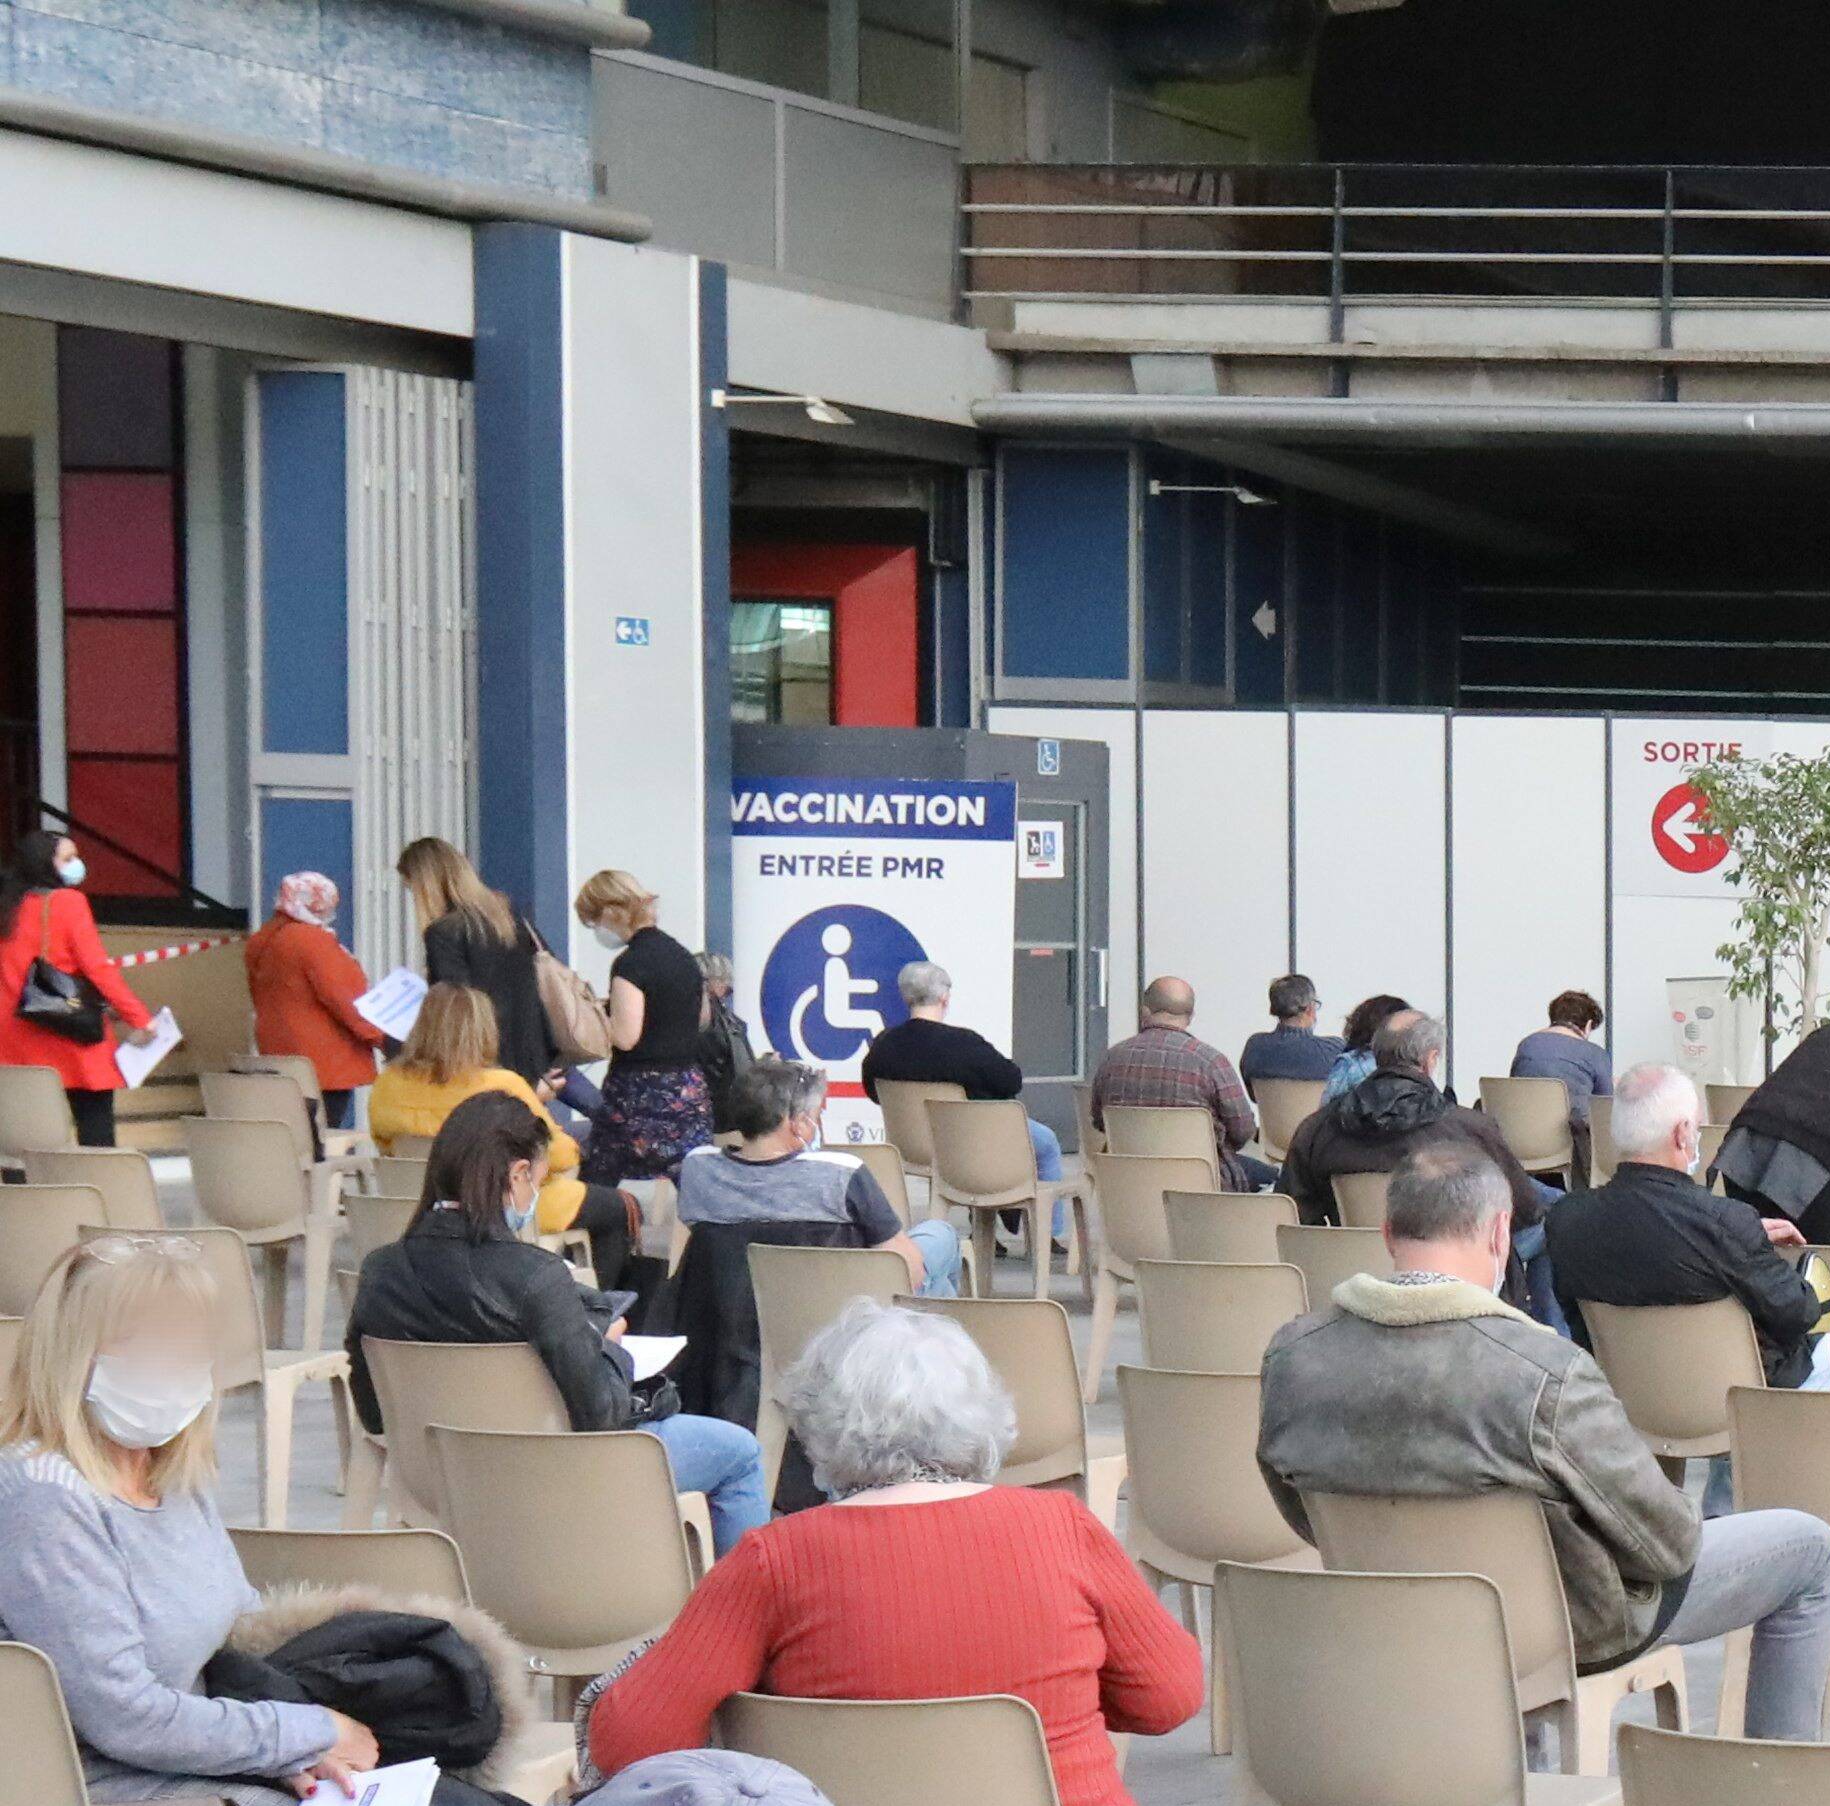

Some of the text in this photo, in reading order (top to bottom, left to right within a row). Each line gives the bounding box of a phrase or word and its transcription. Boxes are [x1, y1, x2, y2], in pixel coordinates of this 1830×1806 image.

[731, 792, 986, 827] VACCINATION
[760, 850, 945, 879] ENTRÉE PMR
